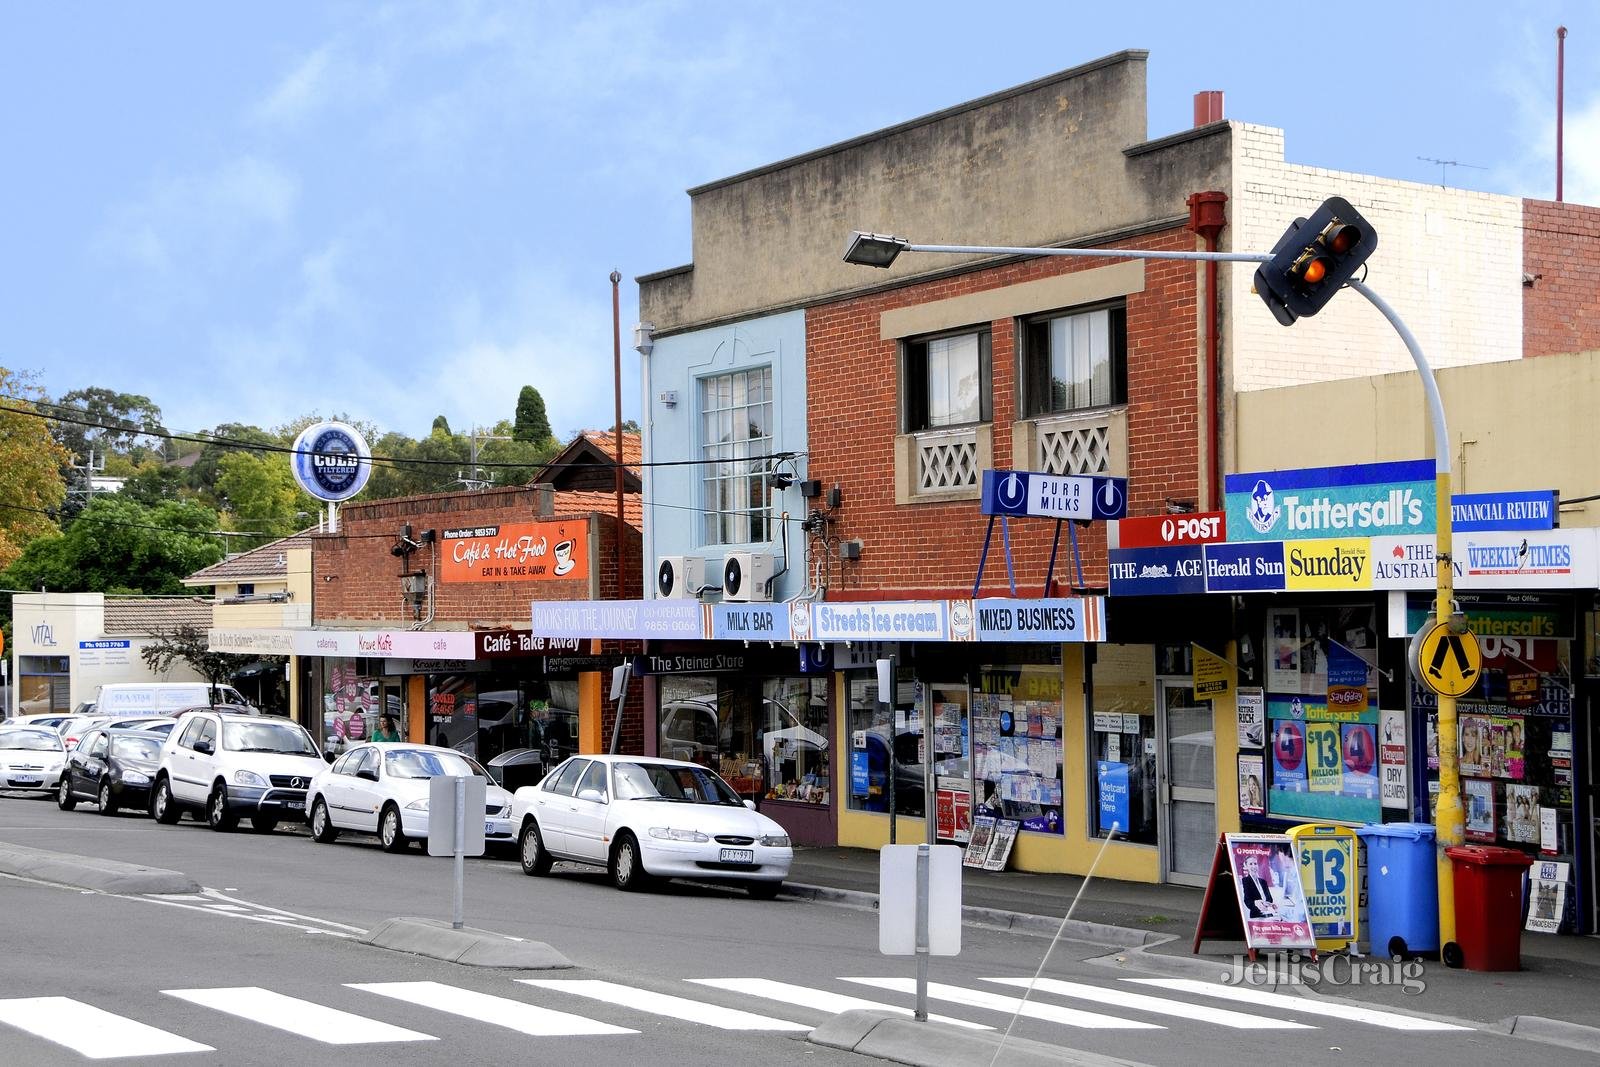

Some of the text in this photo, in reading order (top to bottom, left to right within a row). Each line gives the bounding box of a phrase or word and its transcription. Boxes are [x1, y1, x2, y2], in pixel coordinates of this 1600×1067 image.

[314, 453, 358, 467] COLD
[318, 466, 355, 474] FILTERED
[1042, 481, 1080, 497] PURA
[1041, 496, 1079, 511] MILKS
[1283, 488, 1423, 531] Tattersall's
[1451, 500, 1550, 522] FINANCIAL REVIEW
[444, 527, 496, 539] Phone Order: 9853 5771
[1178, 517, 1220, 539] POST
[453, 535, 547, 567] Café & Hot Food
[1406, 545, 1433, 560] THE
[1468, 545, 1570, 568] WEEKLY TIMES
[482, 565, 546, 576] EAT IN & TAKE AWAY
[1110, 559, 1203, 579] THE AGE
[1208, 557, 1284, 577] Herald Sun
[1290, 547, 1365, 582] Sunday
[1375, 561, 1463, 579] AUSTRALN
[535, 606, 639, 632] BOOKS FOR THE JOURNEY
[644, 620, 696, 632] 9855 0066
[727, 611, 774, 630] MILK BAR
[821, 606, 937, 632] Streets ice cream
[980, 607, 1075, 631] MIXED BUSINESS
[1464, 615, 1554, 636] attersall's
[316, 638, 338, 651] catering
[358, 635, 376, 651] Krave
[433, 638, 447, 651] cafe
[484, 633, 510, 652] Café
[518, 633, 544, 651] Take
[549, 638, 580, 653] Away
[650, 654, 744, 671] The Steiner Store
[982, 674, 1061, 695] MILK BAR
[1488, 704, 1506, 715] SERVICE
[1536, 701, 1569, 715] AGE
[1239, 713, 1254, 723] RICH
[1308, 730, 1339, 768] $13
[1382, 746, 1405, 764] Penguin
[1311, 769, 1339, 777] MILLION
[1387, 768, 1402, 782] DRY
[1101, 781, 1126, 793] Metcard
[1384, 784, 1406, 799] CLEANERS
[1101, 791, 1115, 802] Sold
[1101, 801, 1115, 812] Here
[1301, 848, 1346, 895] $13
[1308, 906, 1346, 916] ACKPOT
